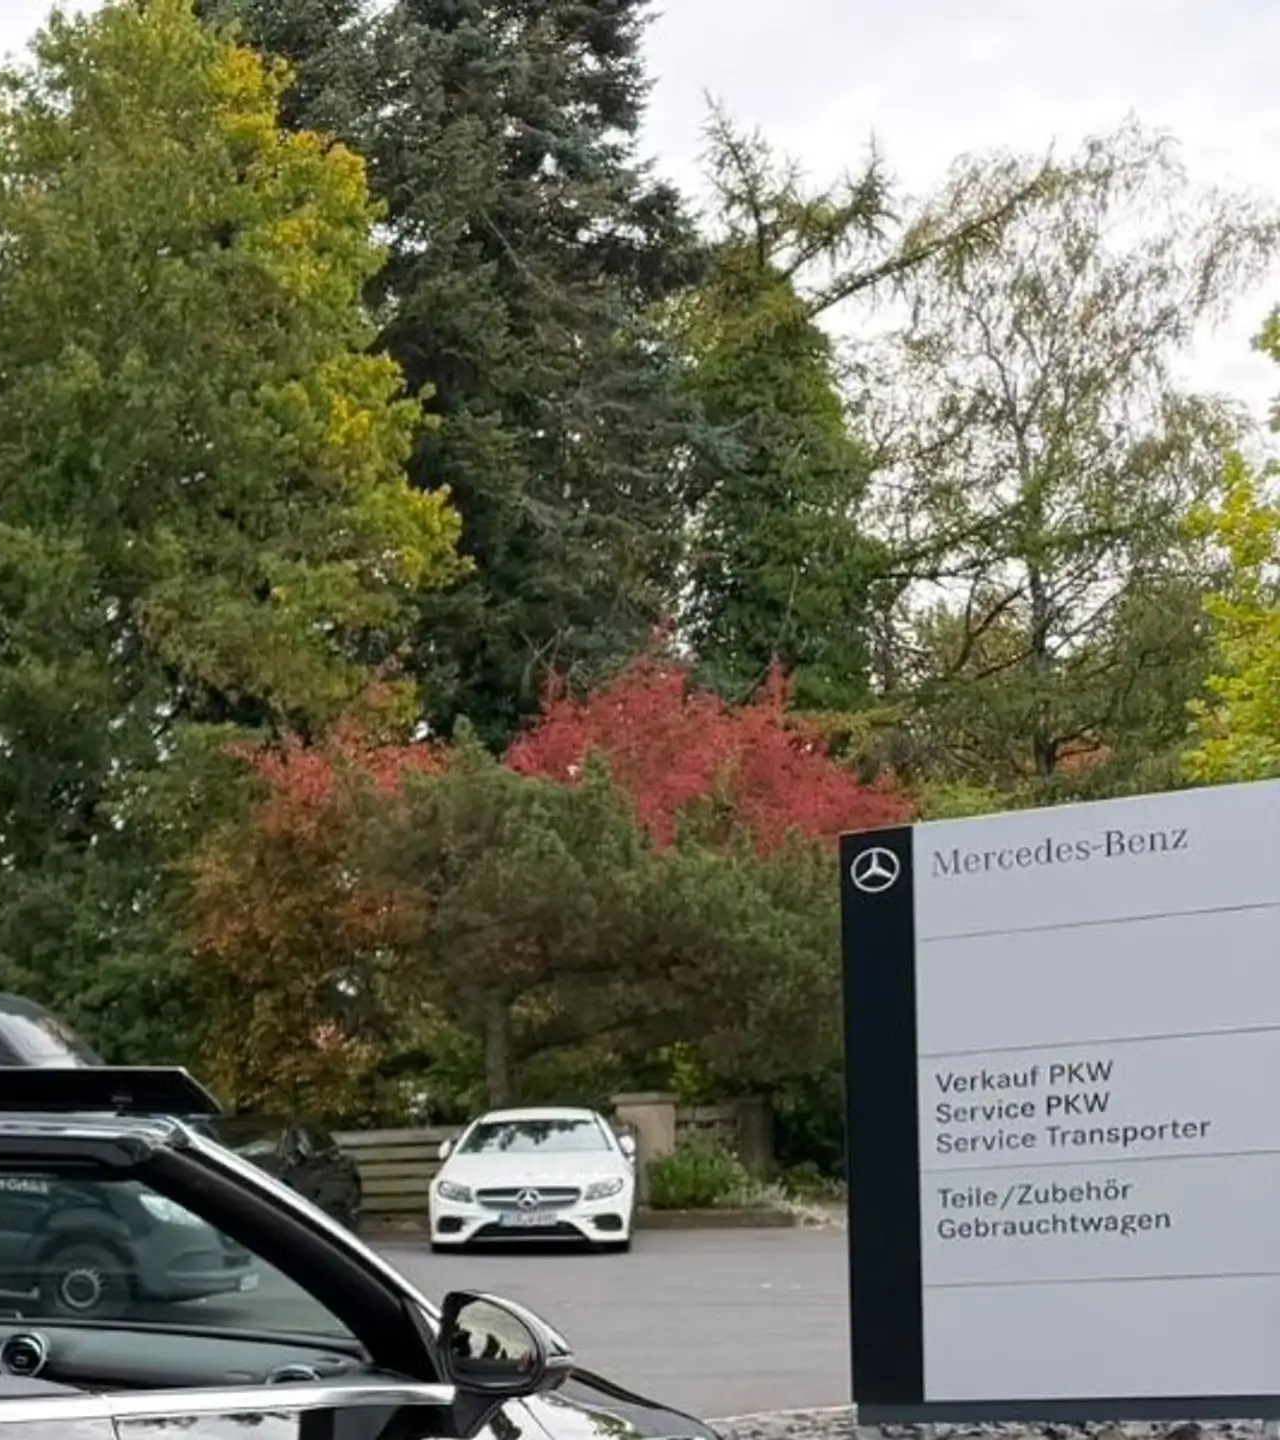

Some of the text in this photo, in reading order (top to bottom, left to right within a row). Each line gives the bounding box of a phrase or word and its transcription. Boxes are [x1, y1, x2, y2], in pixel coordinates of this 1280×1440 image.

[931, 826, 1189, 878] Mercedes-Benz
[935, 1060, 1114, 1094] Verkauf PKW
[935, 1091, 1111, 1125] Service PKW
[935, 1119, 1212, 1154] Service Transporter
[937, 1178, 1134, 1211] Teile/Zubehör
[936, 1210, 1172, 1240] Gebrauchtwagen
